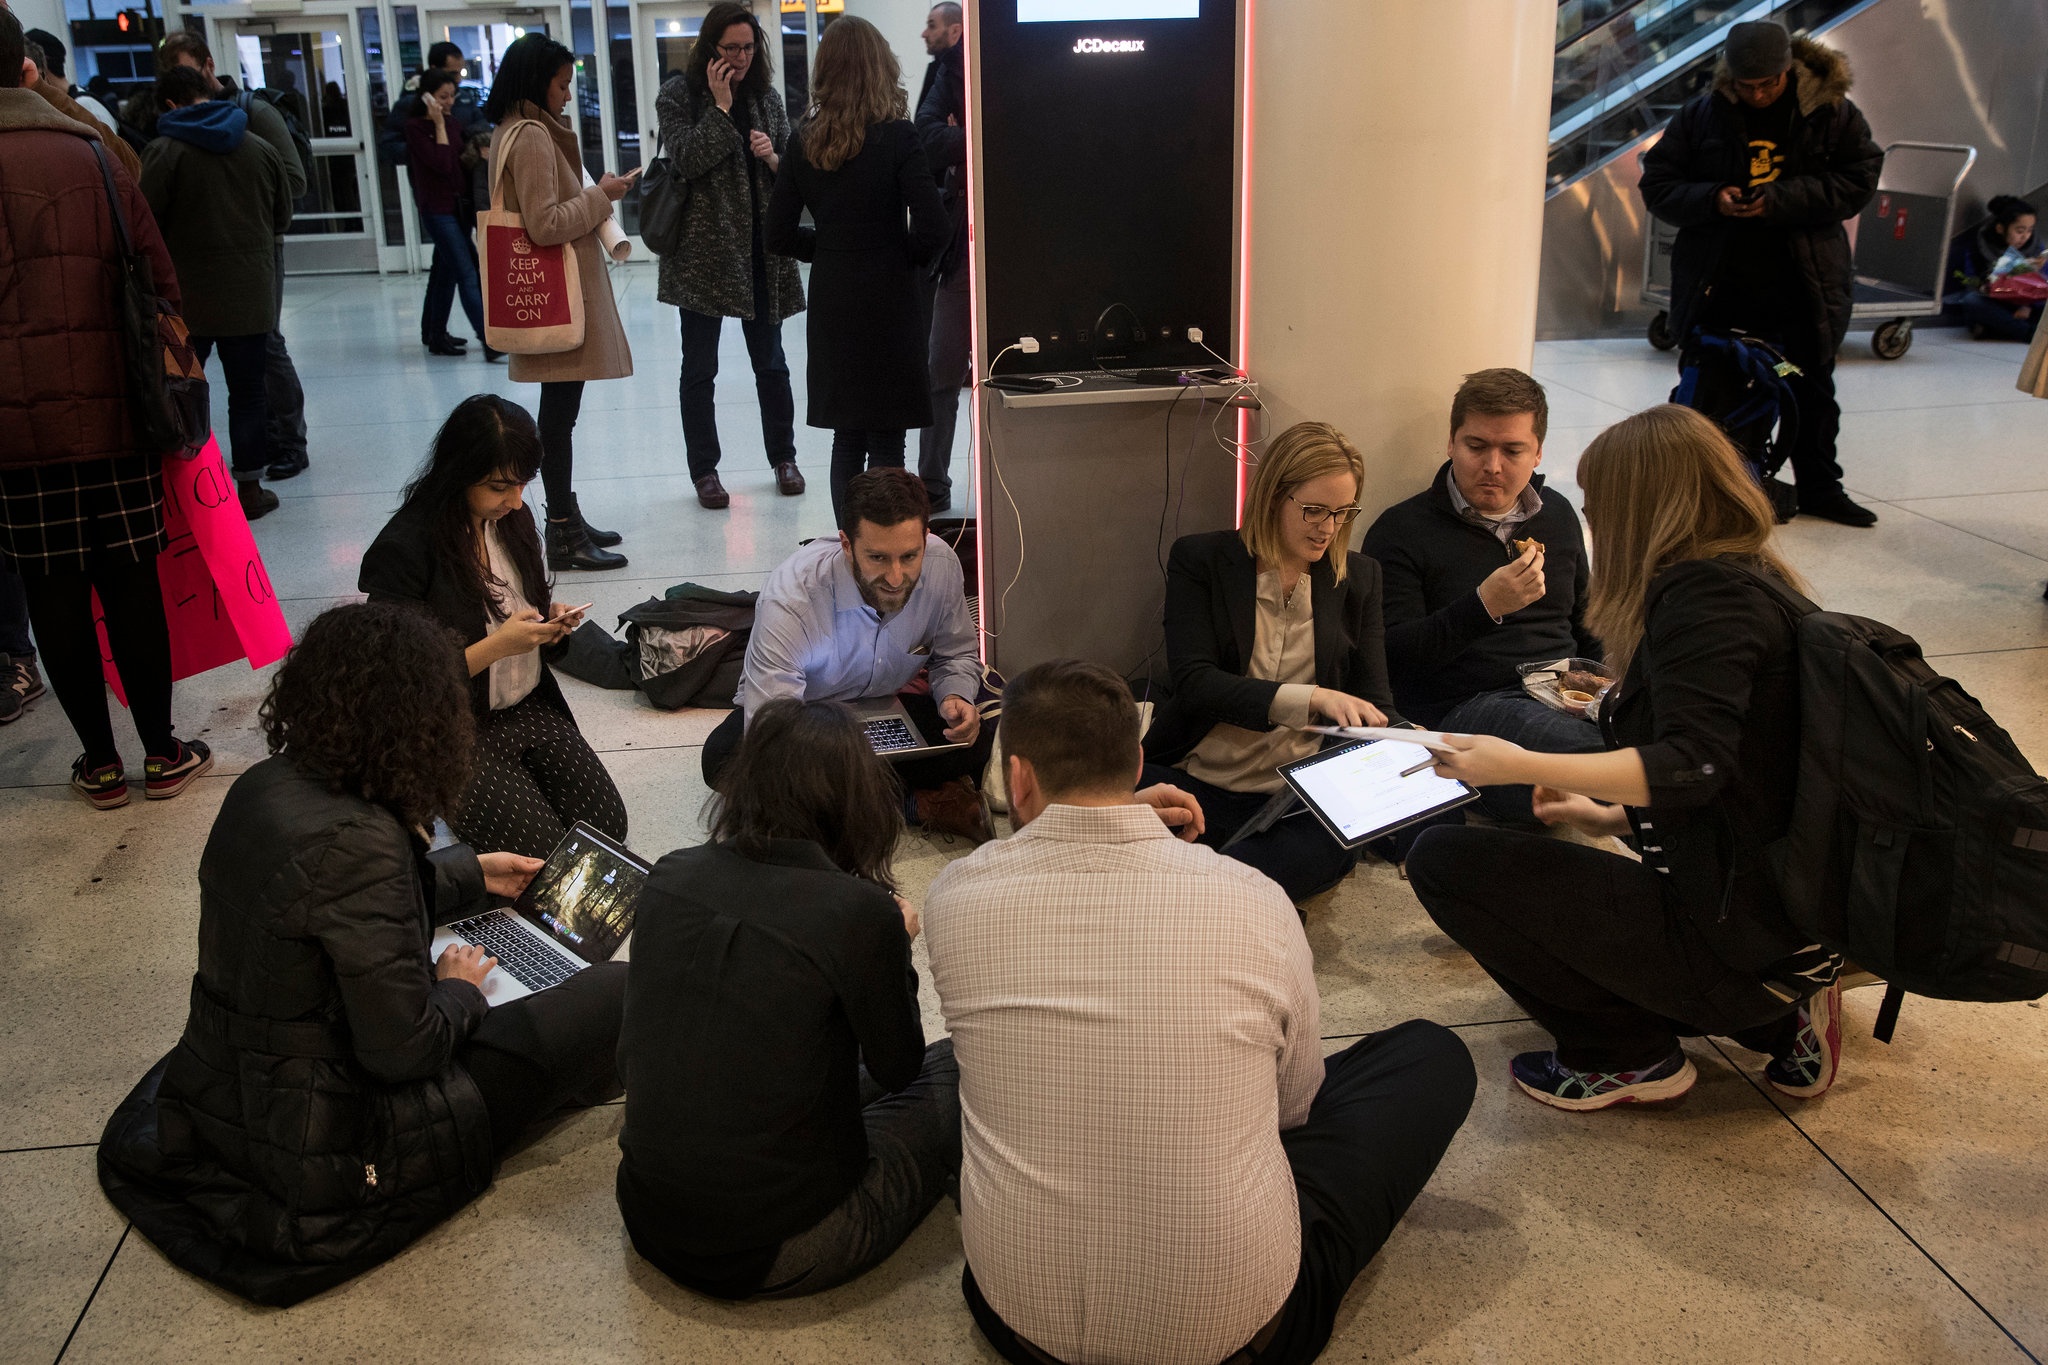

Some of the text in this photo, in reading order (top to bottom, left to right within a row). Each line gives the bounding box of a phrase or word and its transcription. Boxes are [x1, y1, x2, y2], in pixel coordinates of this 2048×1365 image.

[1072, 38, 1145, 54] JCDecaux
[510, 257, 539, 270] KEEP
[508, 271, 544, 284] CALM
[506, 292, 550, 306] CARRY
[517, 308, 541, 321] ON
[147, 764, 162, 773] NIKE
[100, 770, 117, 783] NIKE
